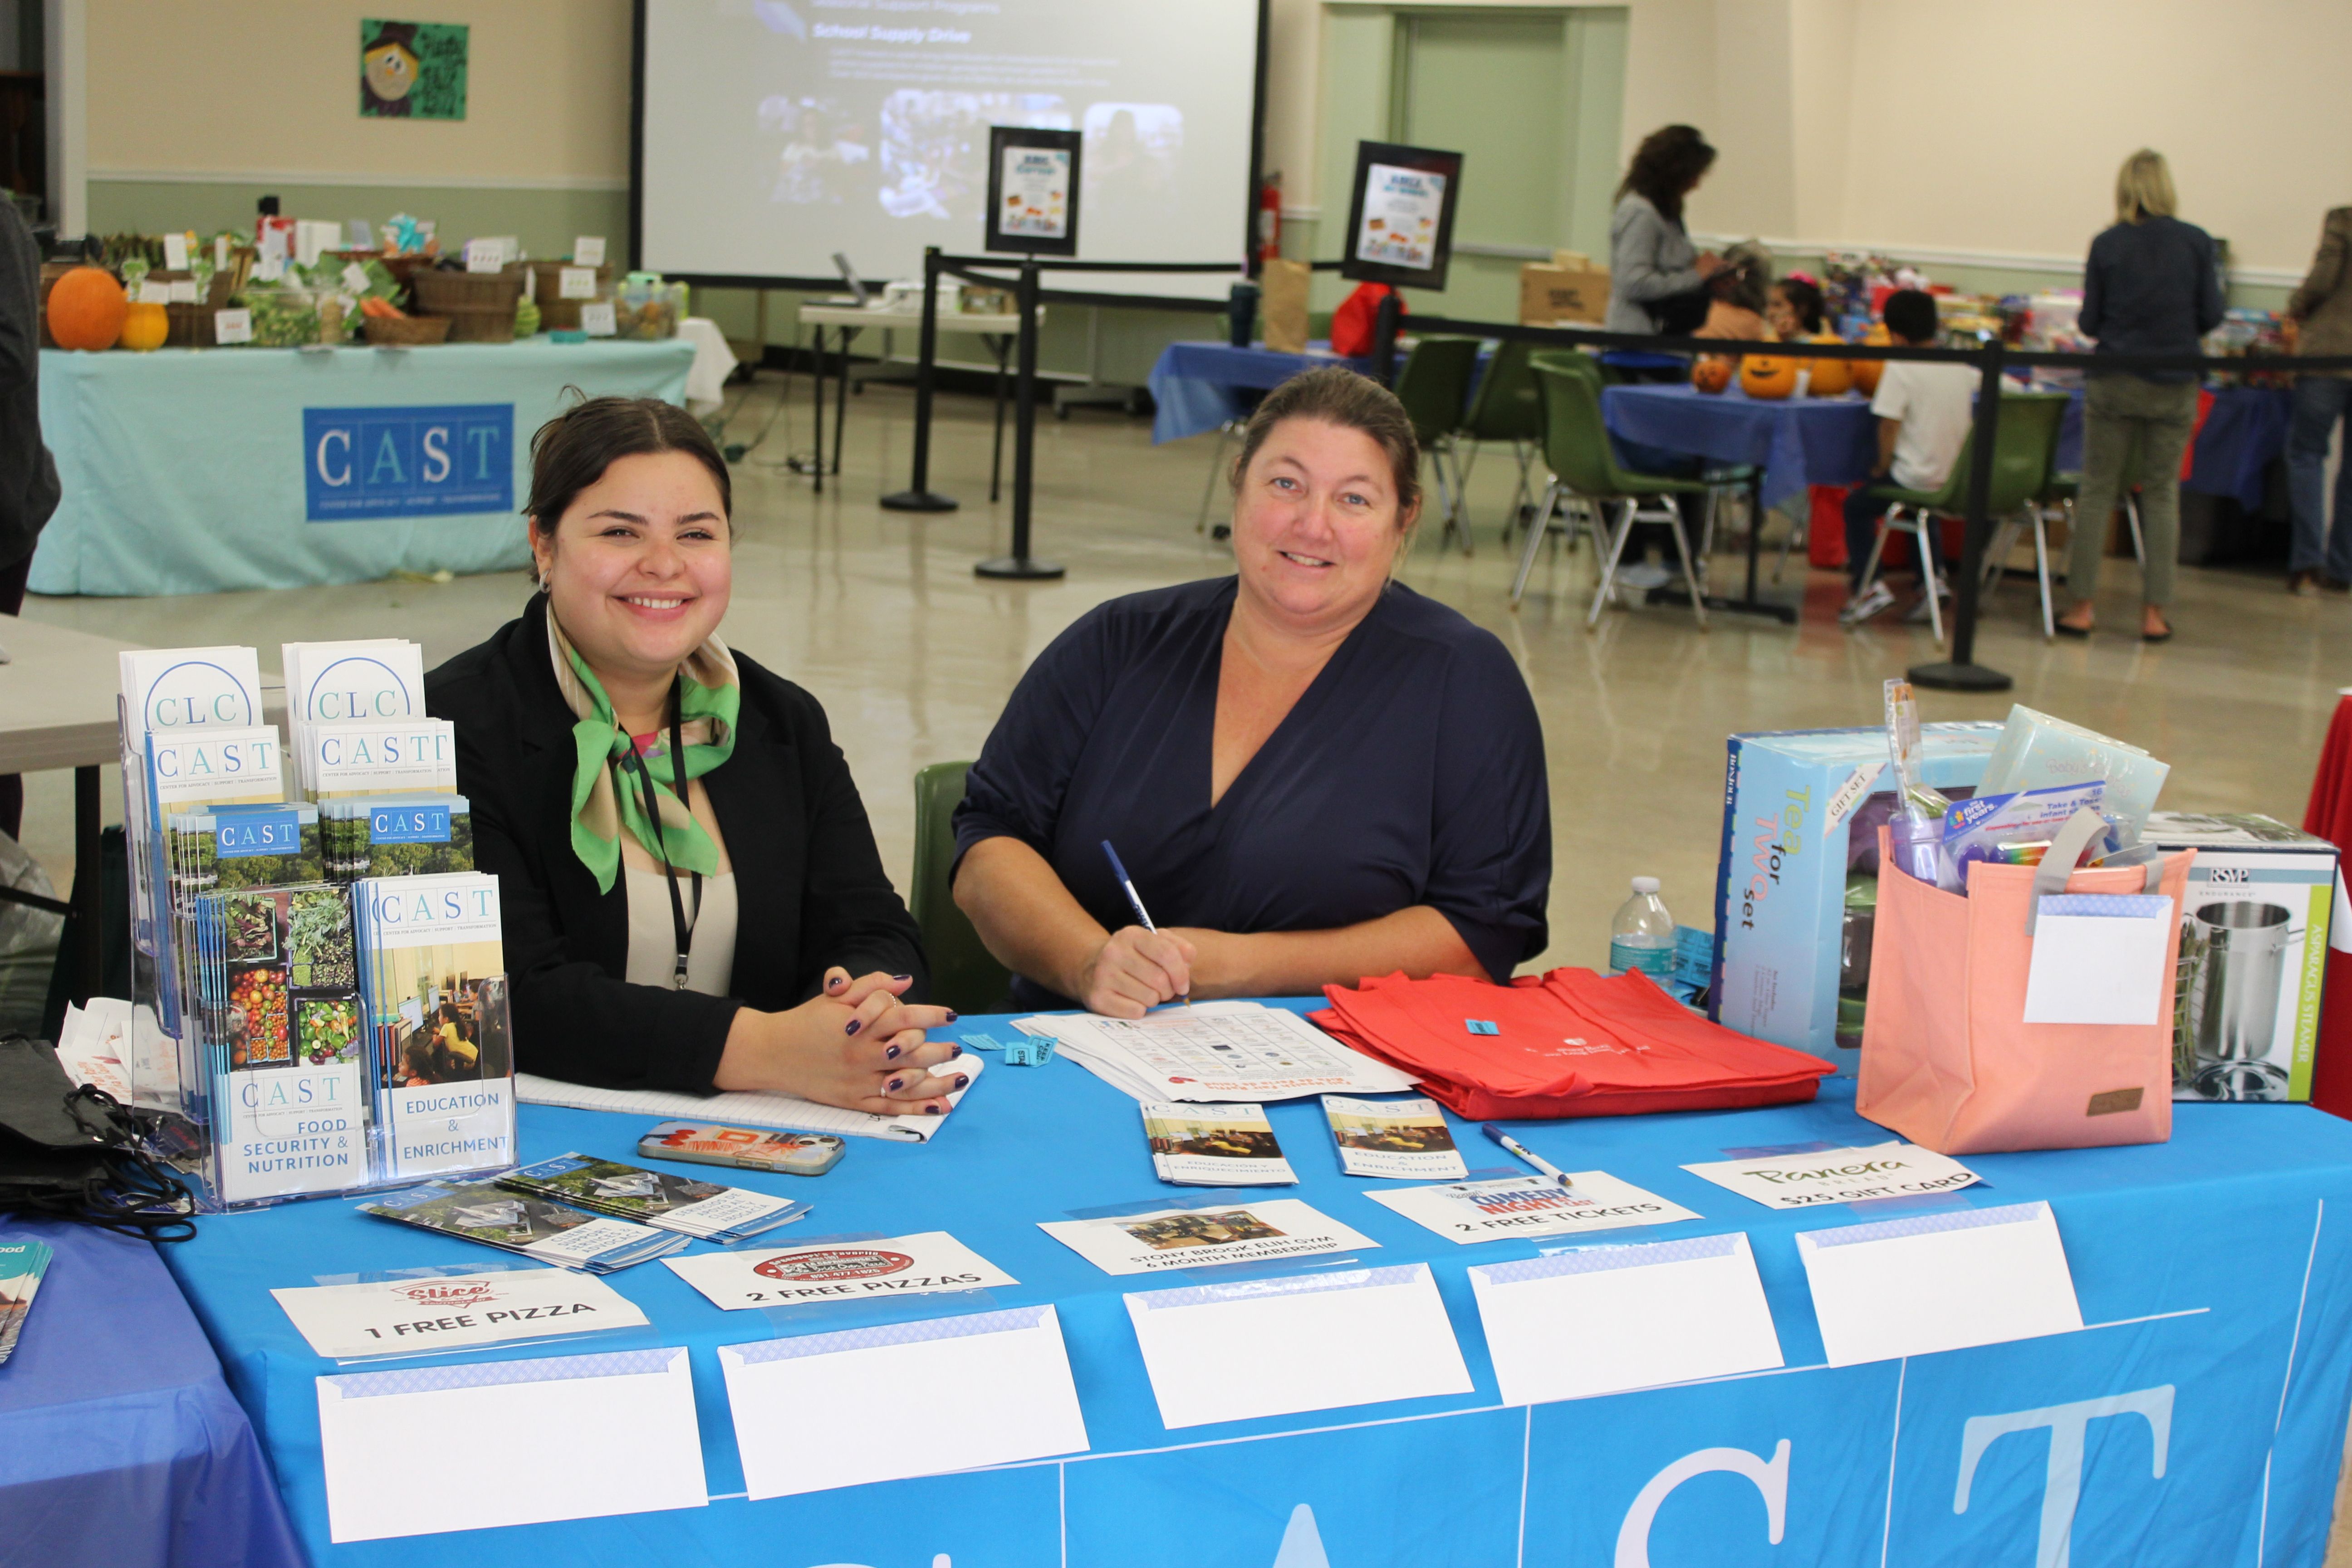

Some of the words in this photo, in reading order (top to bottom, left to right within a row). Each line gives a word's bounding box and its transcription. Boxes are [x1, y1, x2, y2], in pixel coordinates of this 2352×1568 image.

[813, 23, 868, 38] School
[870, 25, 926, 44] Supply
[927, 27, 971, 43] Drive
[317, 426, 498, 486] CAST
[156, 694, 237, 726] CLC
[319, 690, 396, 720] CLC
[157, 743, 272, 777] CAST
[322, 735, 429, 765] CAST
[1832, 791, 1850, 816] GIFT
[1850, 774, 1867, 793] SET
[1964, 800, 1985, 815] first
[1965, 804, 1995, 824] years
[2040, 809, 2067, 818] infant
[375, 813, 444, 833] CAST
[1784, 784, 1810, 855] Tea
[222, 824, 293, 846] CAST
[1770, 844, 1786, 885] for
[2211, 868, 2249, 883] RSVP
[382, 890, 493, 923] CAST
[1742, 888, 1754, 930] set
[2303, 924, 2323, 1002] ASPARAGUS
[2298, 1005, 2314, 1063] STEAMER
[242, 1078, 340, 1107] CAST
[407, 1093, 499, 1114] EDUCATION
[1152, 1105, 1255, 1115] CAST
[1326, 1099, 1428, 1112] CAST
[298, 1119, 347, 1134] FOOD
[448, 1119, 458, 1132] &
[244, 1137, 330, 1156] SECURITY
[338, 1136, 348, 1148] &
[404, 1137, 509, 1159] ENRICHMENT
[1355, 1152, 1447, 1160] EDUCATION
[249, 1153, 348, 1173] NUTRITION
[524, 1160, 577, 1178] CAST
[1353, 1162, 1458, 1172] ENRICHMENT
[1742, 1161, 1912, 1184] Panera
[383, 1189, 435, 1207] CAST
[1469, 1188, 1573, 1205] COMEDY
[1780, 1193, 1832, 1205] $25
[1839, 1186, 1896, 1199] GIFT
[1900, 1173, 1973, 1191] CARD
[675, 1197, 726, 1217] SERVICIOS
[1476, 1198, 1563, 1215] NIGHT
[1480, 1215, 1549, 1229] FREE
[1554, 1203, 1663, 1220] TICKETS
[551, 1226, 592, 1242] CLIENT
[558, 1227, 612, 1246] SUPPORT
[566, 1232, 621, 1251] SERVICES
[582, 1230, 643, 1253] ADVOCACY
[1129, 1252, 1186, 1264] STONY
[1190, 1245, 1248, 1256] BROOK
[1254, 1240, 1289, 1250] ELIH
[1161, 1255, 1230, 1267] MONTH
[1231, 1243, 1338, 1259] MEMBERSHIP
[407, 1287, 490, 1300] Slice
[746, 1292, 770, 1301] 2
[777, 1284, 856, 1299] FREE
[863, 1274, 982, 1291] PIZZAS
[365, 1328, 382, 1338] 1
[394, 1315, 477, 1336] FREE
[487, 1303, 597, 1323] PIZZA
